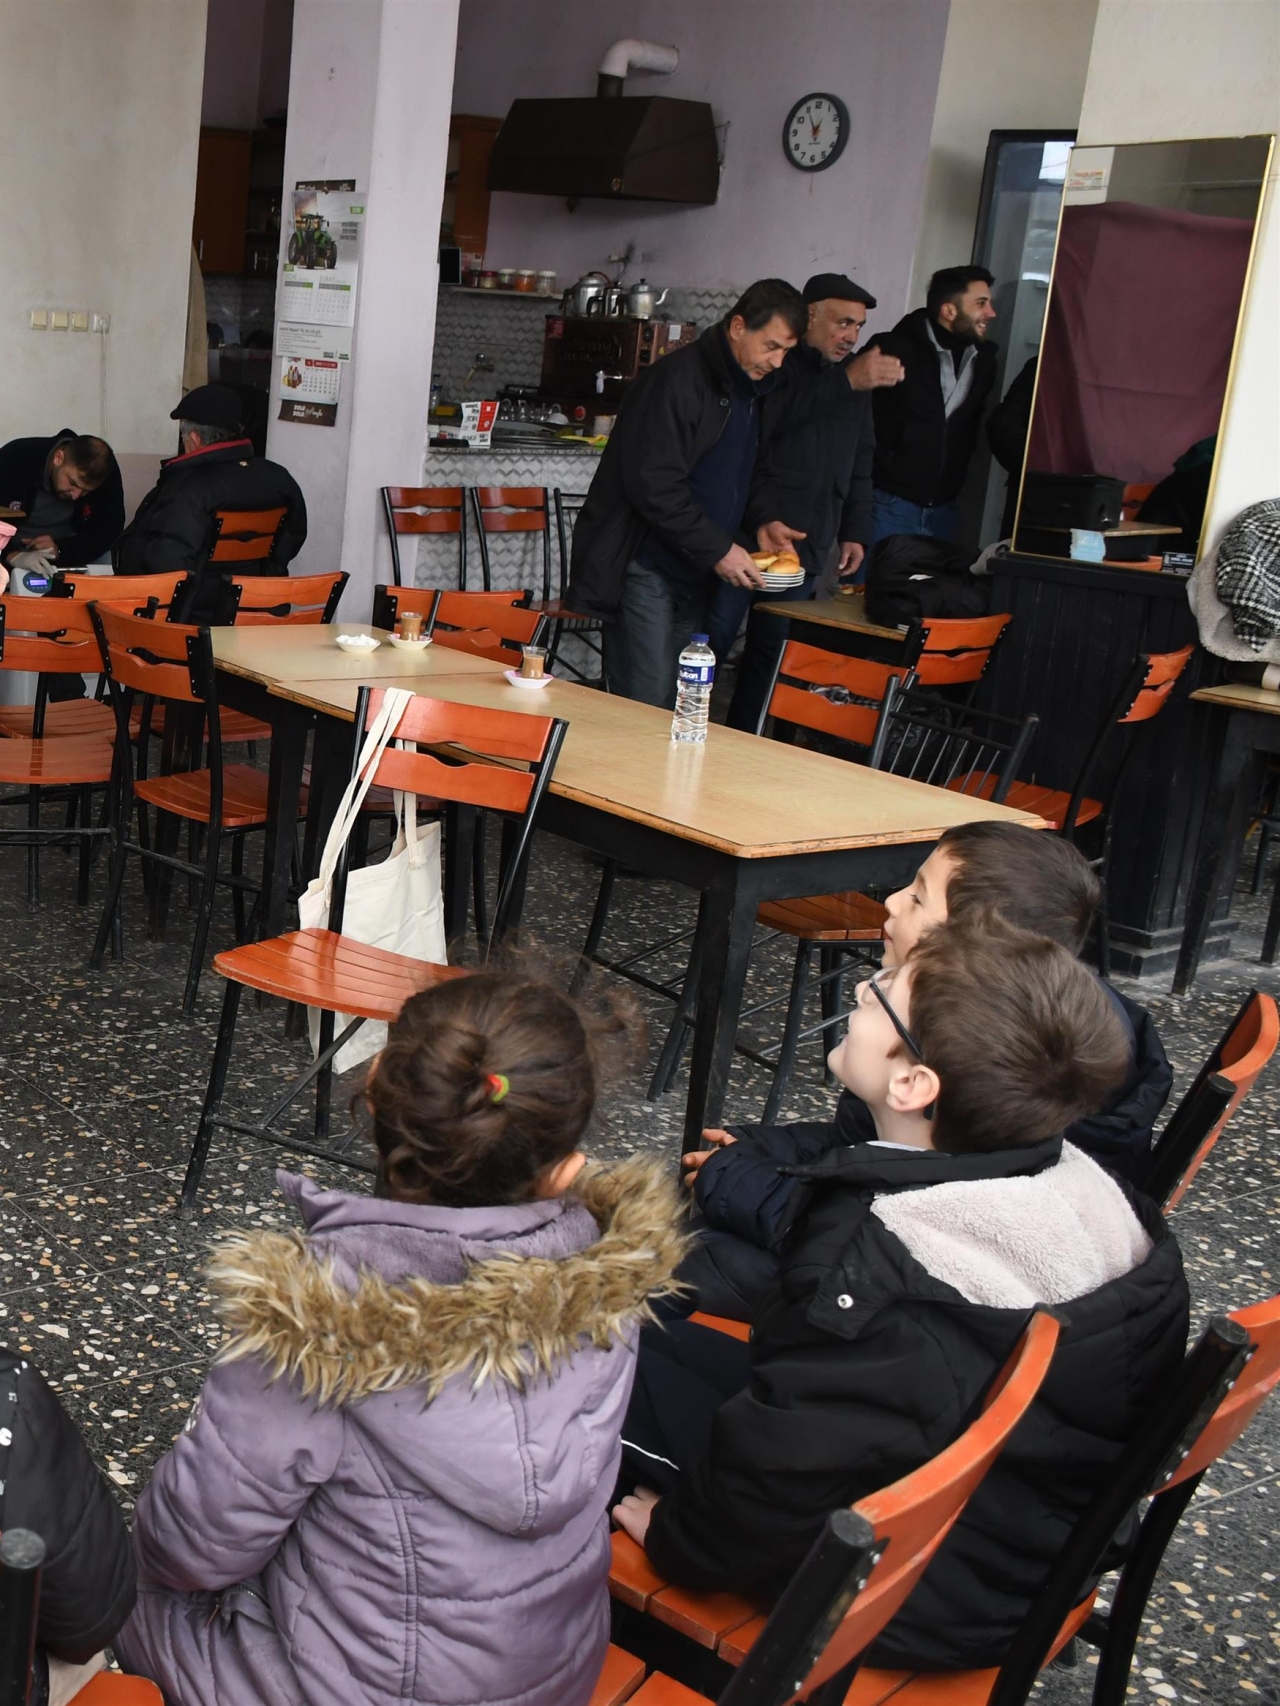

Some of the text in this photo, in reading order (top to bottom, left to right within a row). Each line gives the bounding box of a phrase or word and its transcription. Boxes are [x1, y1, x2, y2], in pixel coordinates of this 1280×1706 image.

[815, 101, 822, 109] 12
[806, 106, 811, 114] 11
[832, 114, 838, 122] 2
[792, 129, 798, 137] 9
[794, 143, 800, 151] 8
[801, 152, 806, 160] 7
[810, 155, 816, 163] 6
[821, 151, 826, 159] 5
